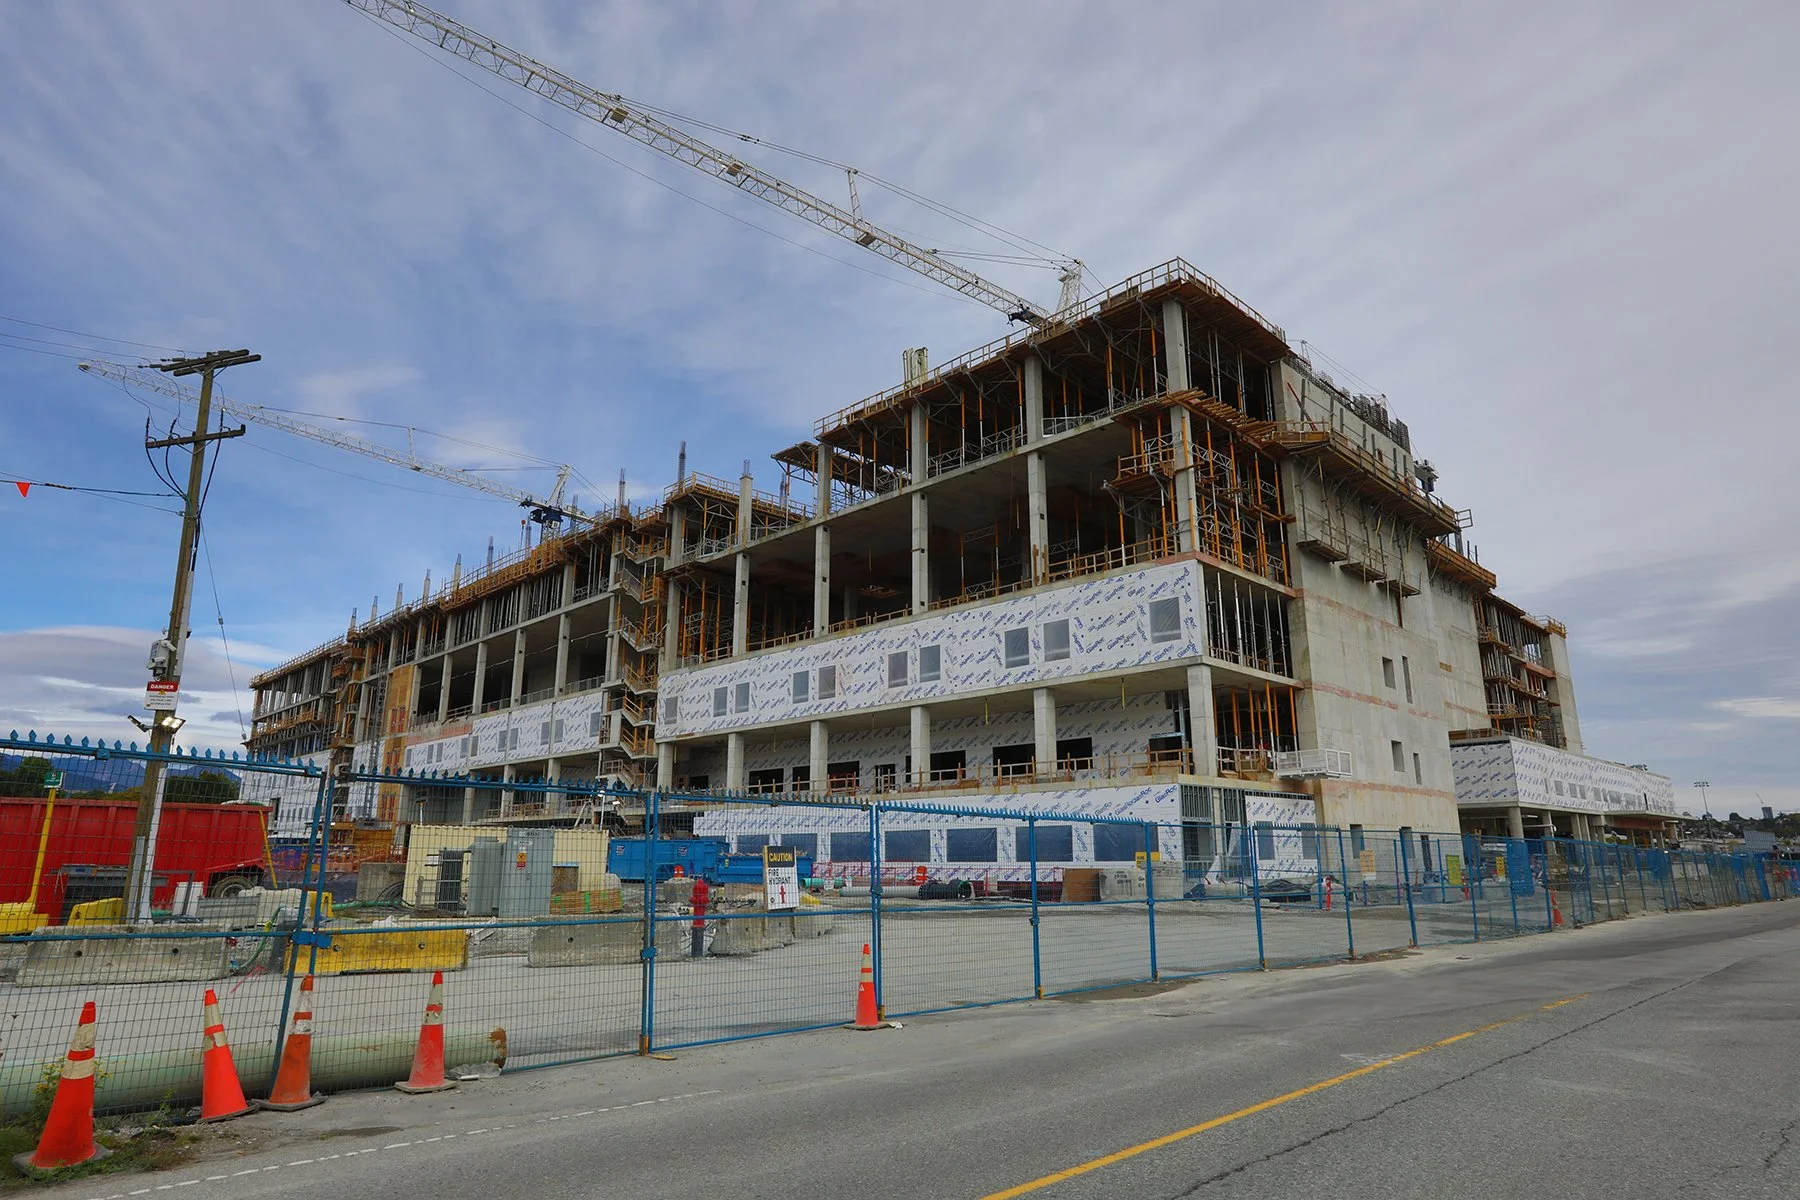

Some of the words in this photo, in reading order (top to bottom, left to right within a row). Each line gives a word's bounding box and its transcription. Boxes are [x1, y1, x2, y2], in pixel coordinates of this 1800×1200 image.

[1155, 785, 1178, 803] GlasRoc
[769, 853, 793, 862] CAUTION
[769, 868, 779, 876] FIRE
[769, 877, 791, 885] HYDRANT
